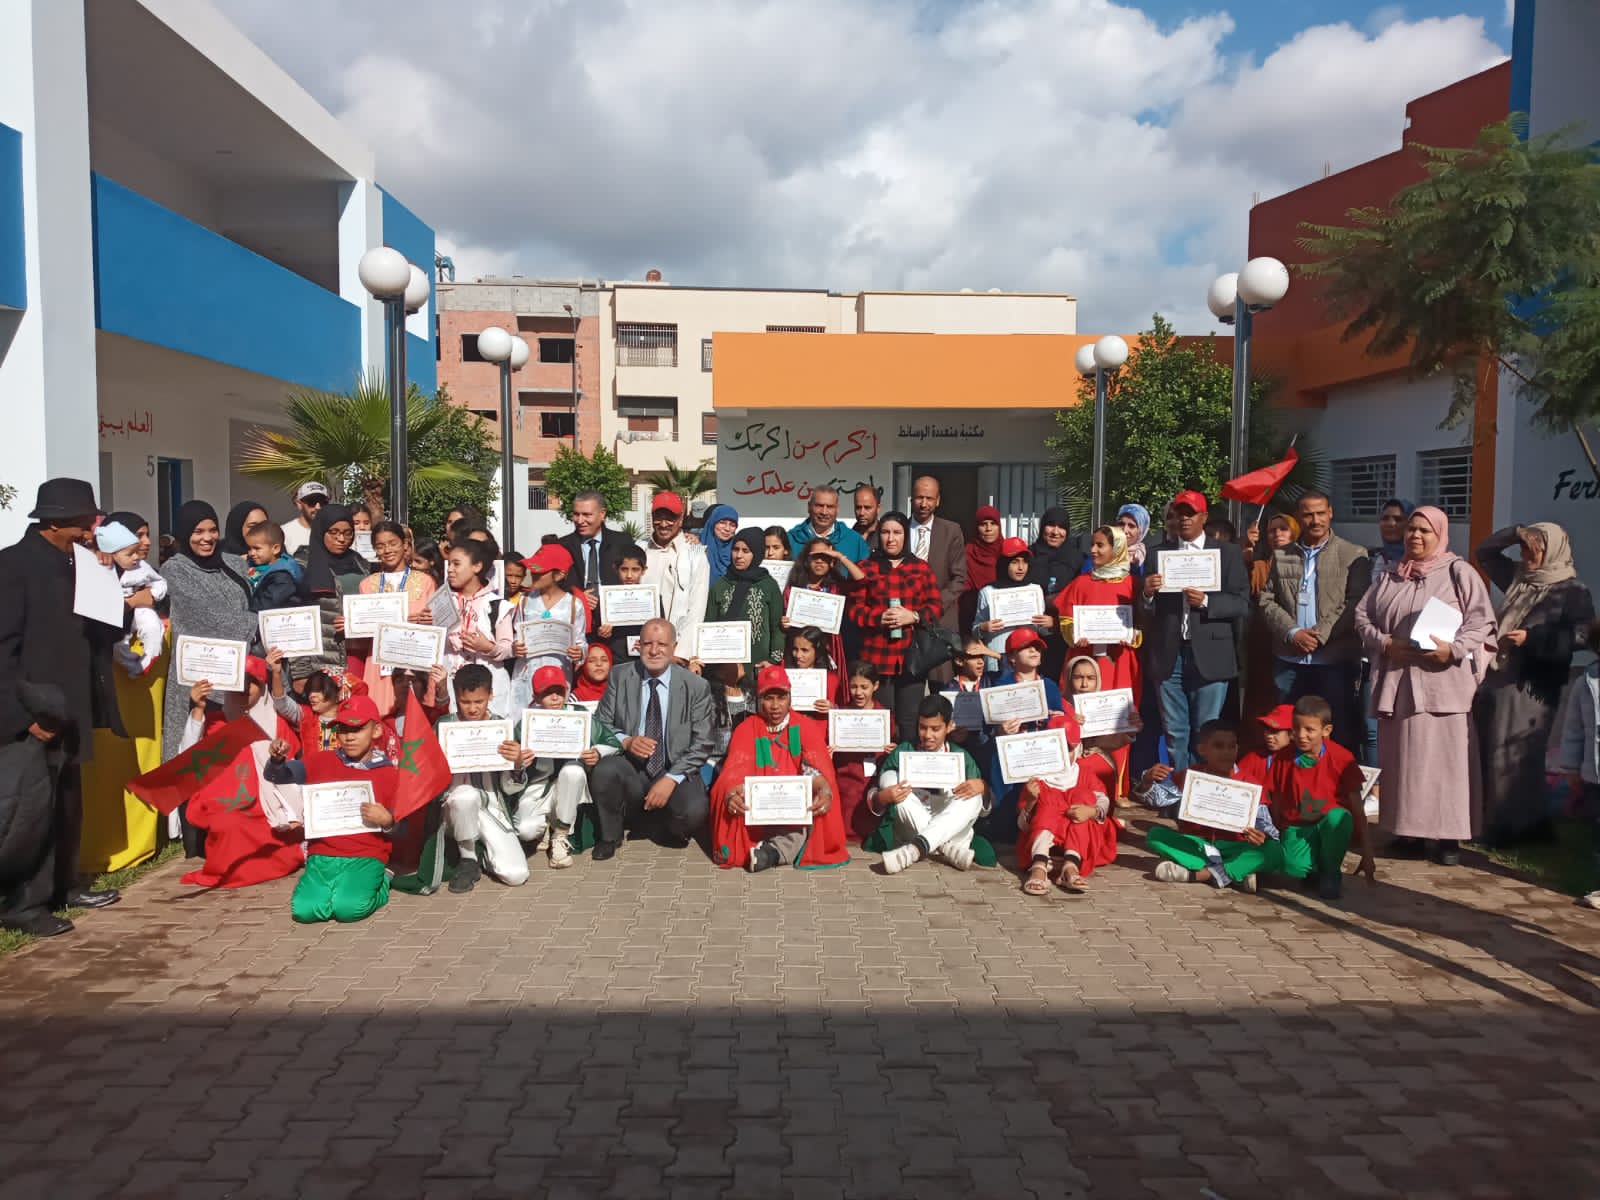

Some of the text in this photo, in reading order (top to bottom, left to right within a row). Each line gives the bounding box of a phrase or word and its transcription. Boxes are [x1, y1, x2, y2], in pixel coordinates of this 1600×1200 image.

[897, 423, 985, 441] مكتبة متعددة الوسائط
[792, 440, 820, 460] من
[146, 455, 155, 478] 5
